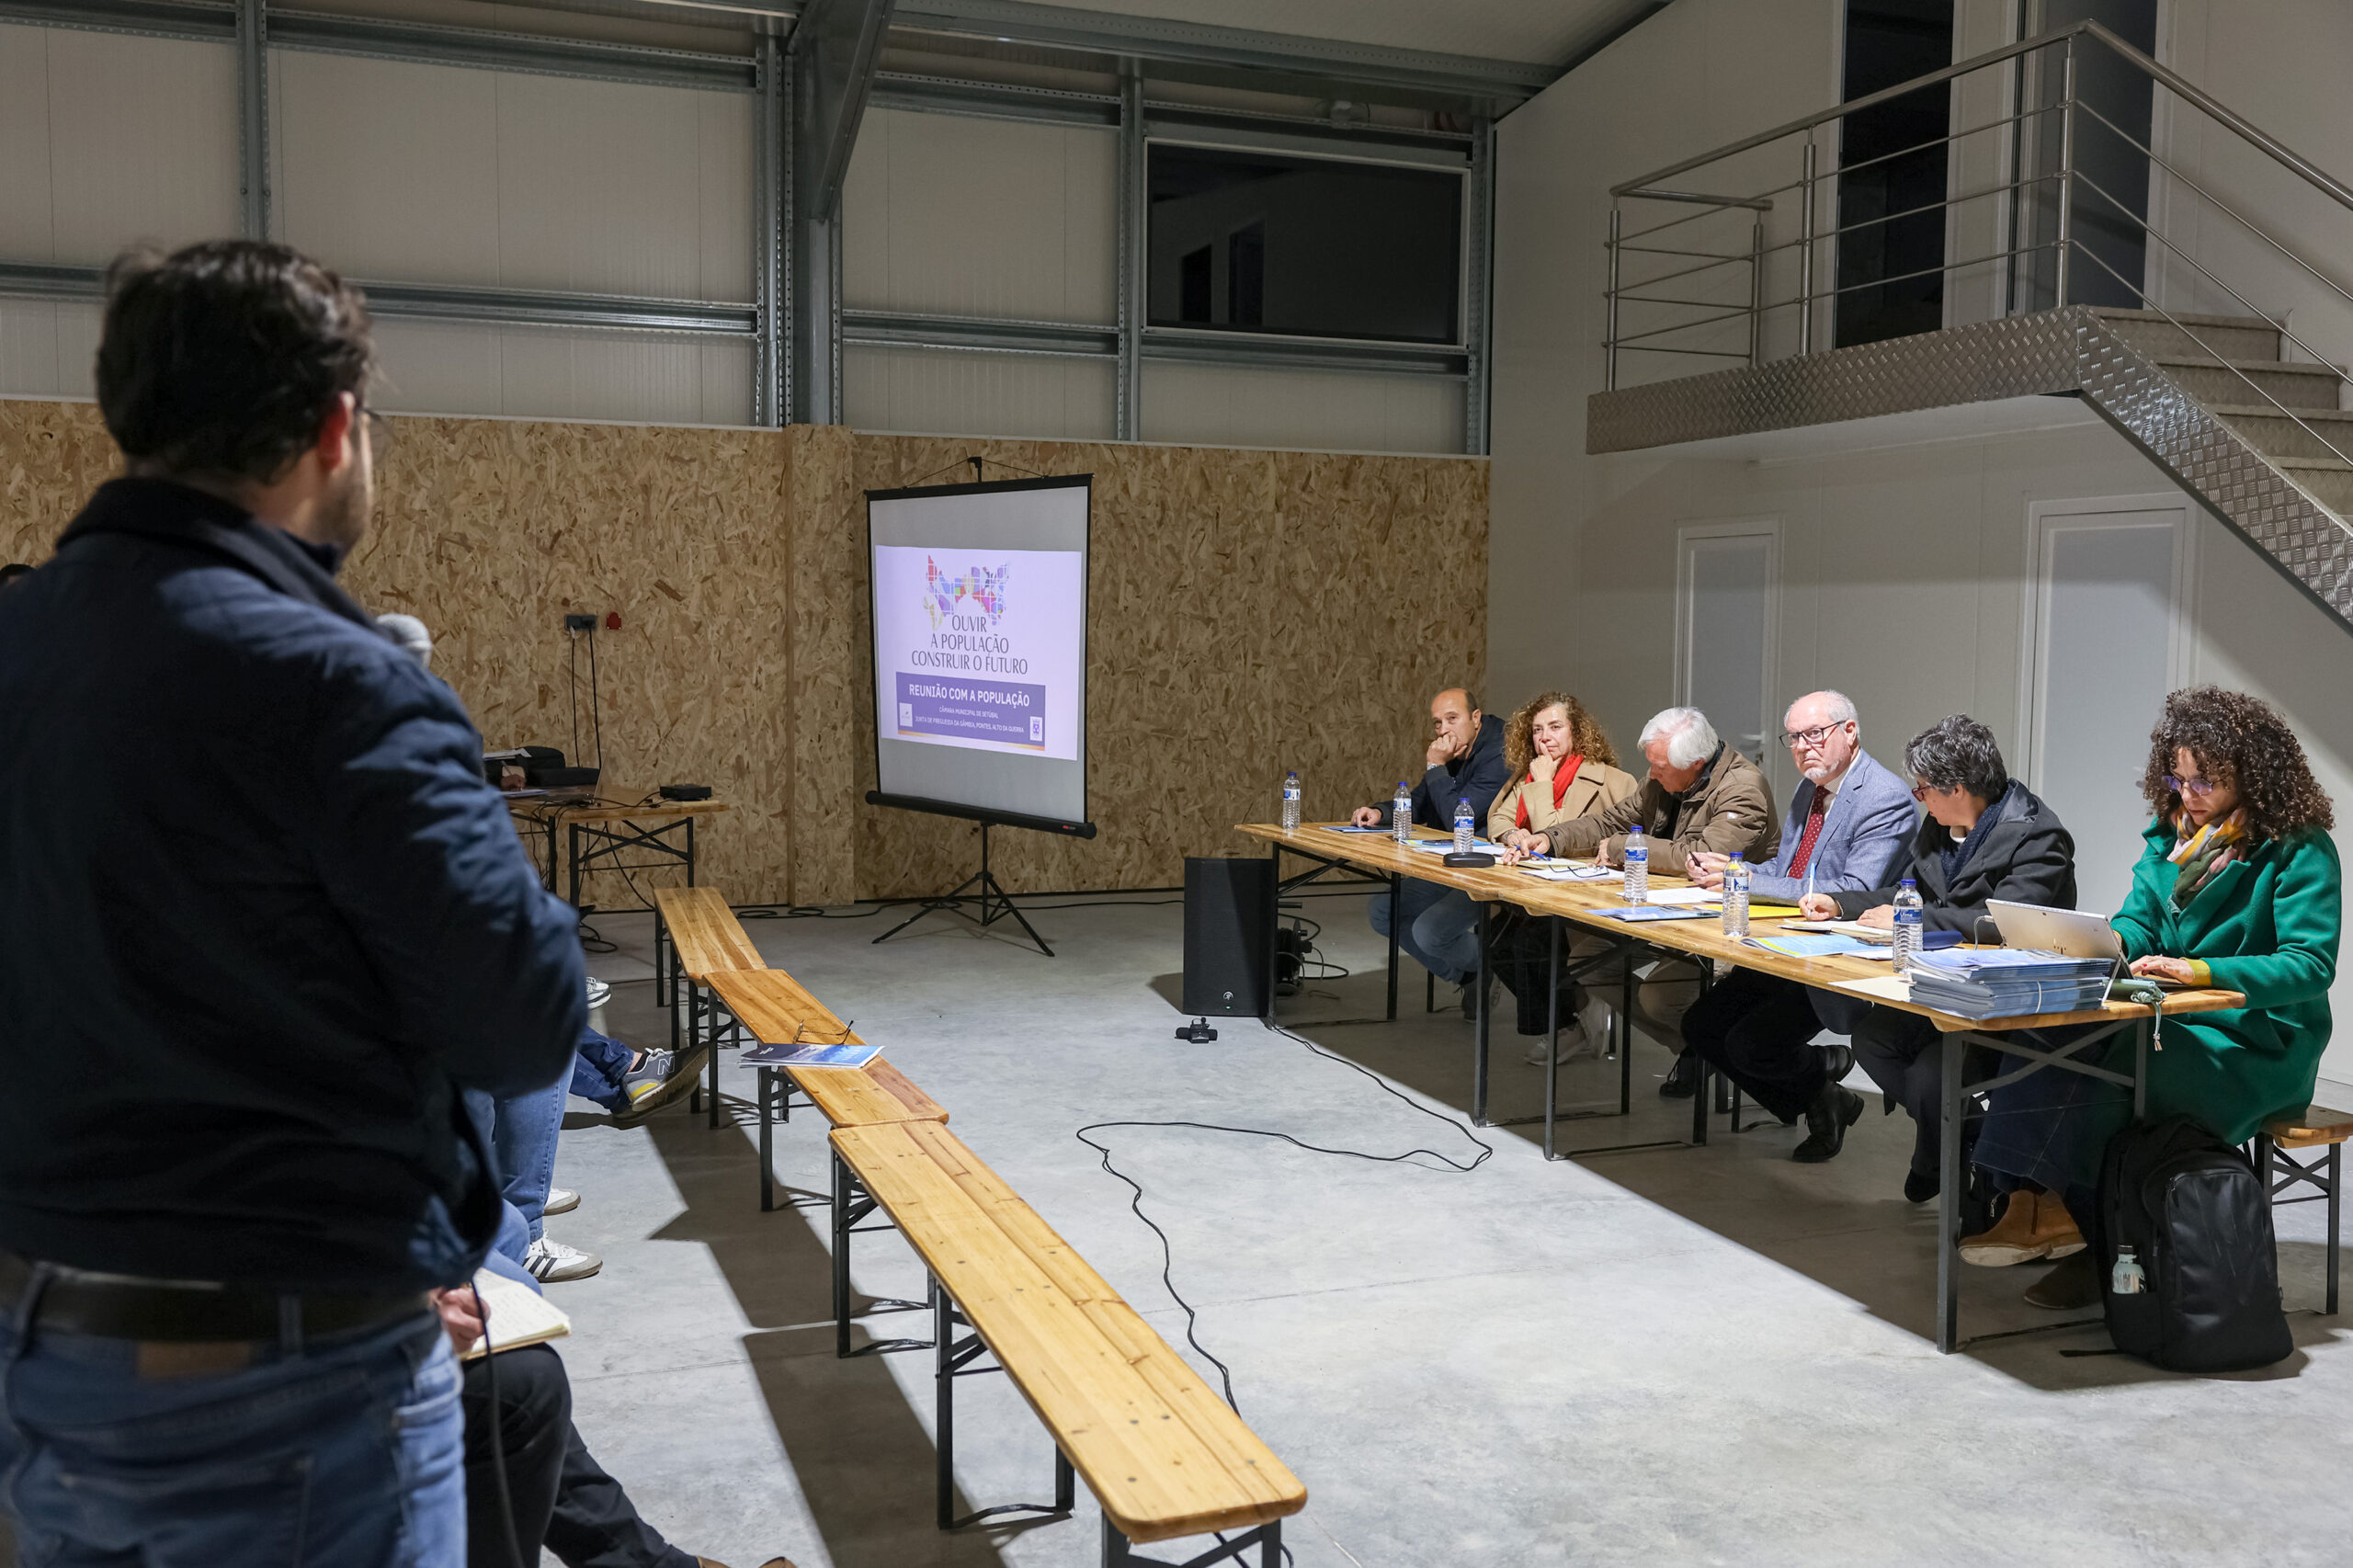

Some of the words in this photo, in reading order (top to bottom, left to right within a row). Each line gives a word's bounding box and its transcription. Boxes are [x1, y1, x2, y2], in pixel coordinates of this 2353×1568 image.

[952, 615, 987, 632] OUVIR
[930, 633, 938, 649] A
[941, 633, 1009, 655] POPULAÇÃO
[912, 650, 971, 670] CONSTRUIR
[972, 655, 983, 671] O
[985, 655, 1029, 676] FUTURO
[909, 683, 948, 699] REUNIÃO
[949, 687, 968, 701] COM
[969, 691, 976, 702] A
[977, 691, 1030, 709] POPULAÇÃO
[657, 1056, 676, 1075] N
